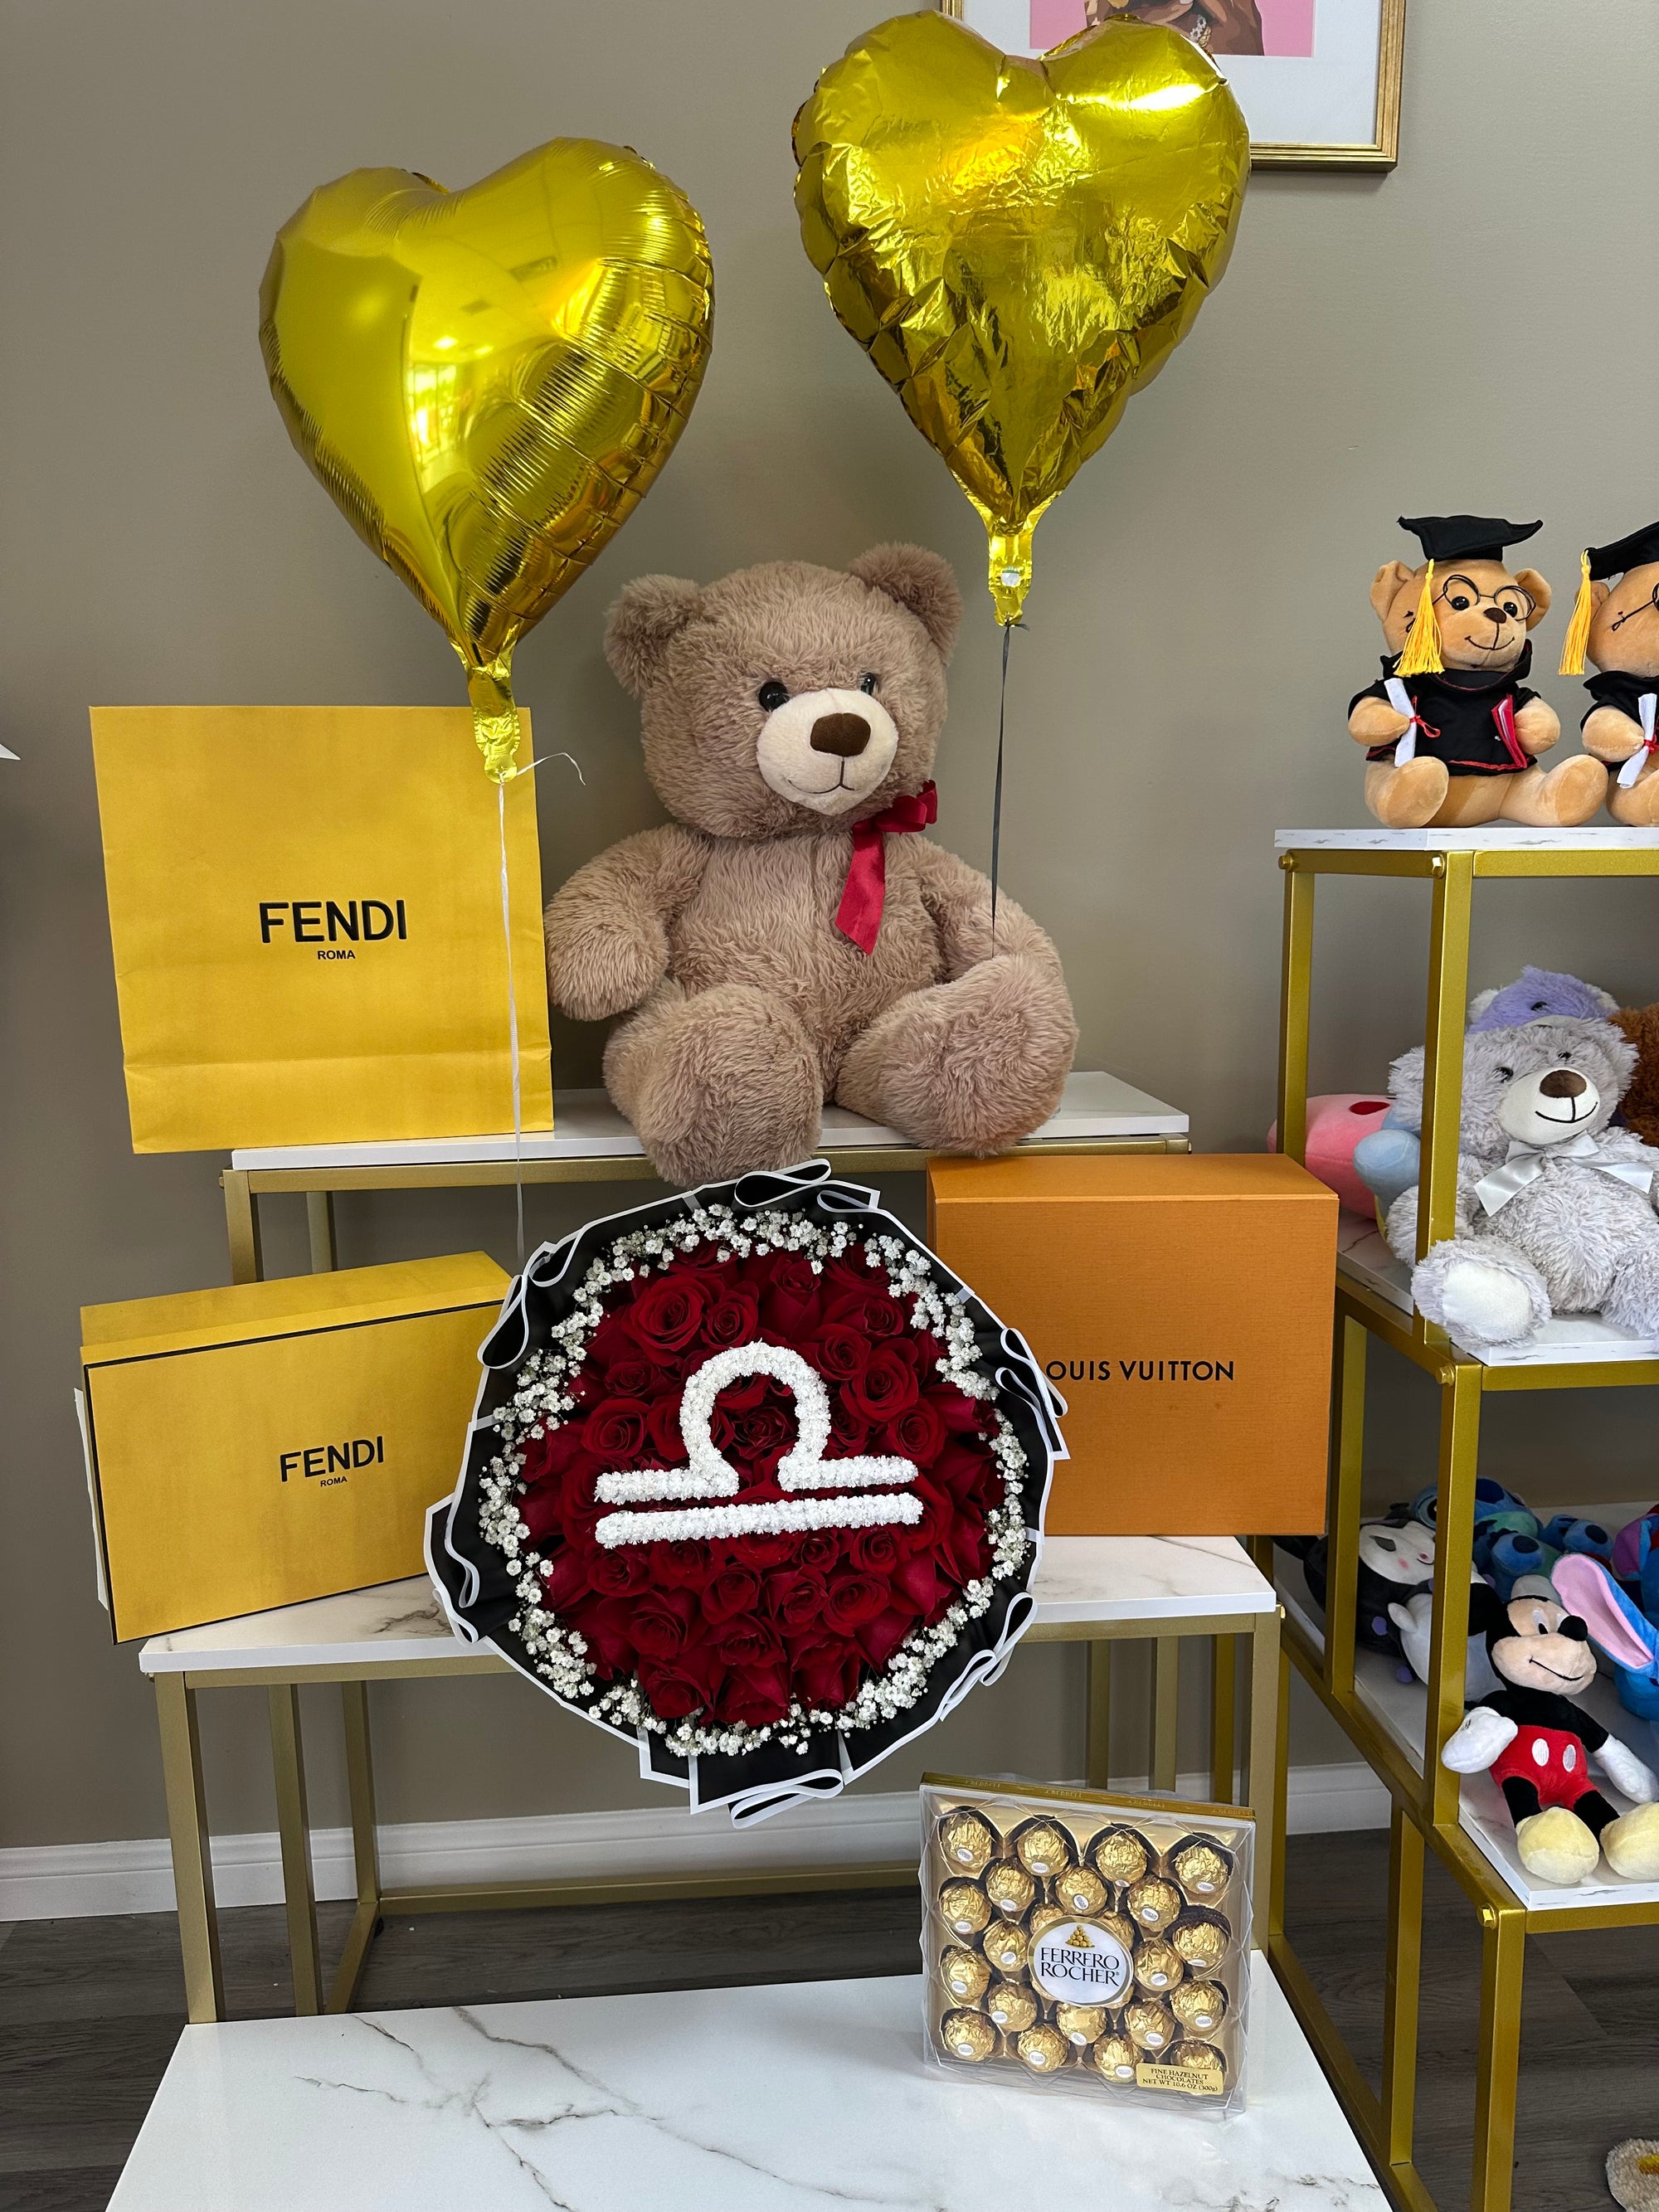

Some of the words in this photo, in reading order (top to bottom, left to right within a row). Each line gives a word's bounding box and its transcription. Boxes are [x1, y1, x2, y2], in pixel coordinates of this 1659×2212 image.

[259, 899, 407, 944] FENDI
[317, 950, 356, 960] ROMA
[1038, 1360, 1111, 1381] OUIS
[1118, 1360, 1234, 1381] VUITTON
[280, 1435, 384, 1483] FENDI
[319, 1475, 348, 1487] ROMA
[1040, 1947, 1120, 1971] FERRERO
[1155, 2073, 1204, 2085] CHOCOLATES
[1169, 2069, 1209, 2080] HAZELNUT
